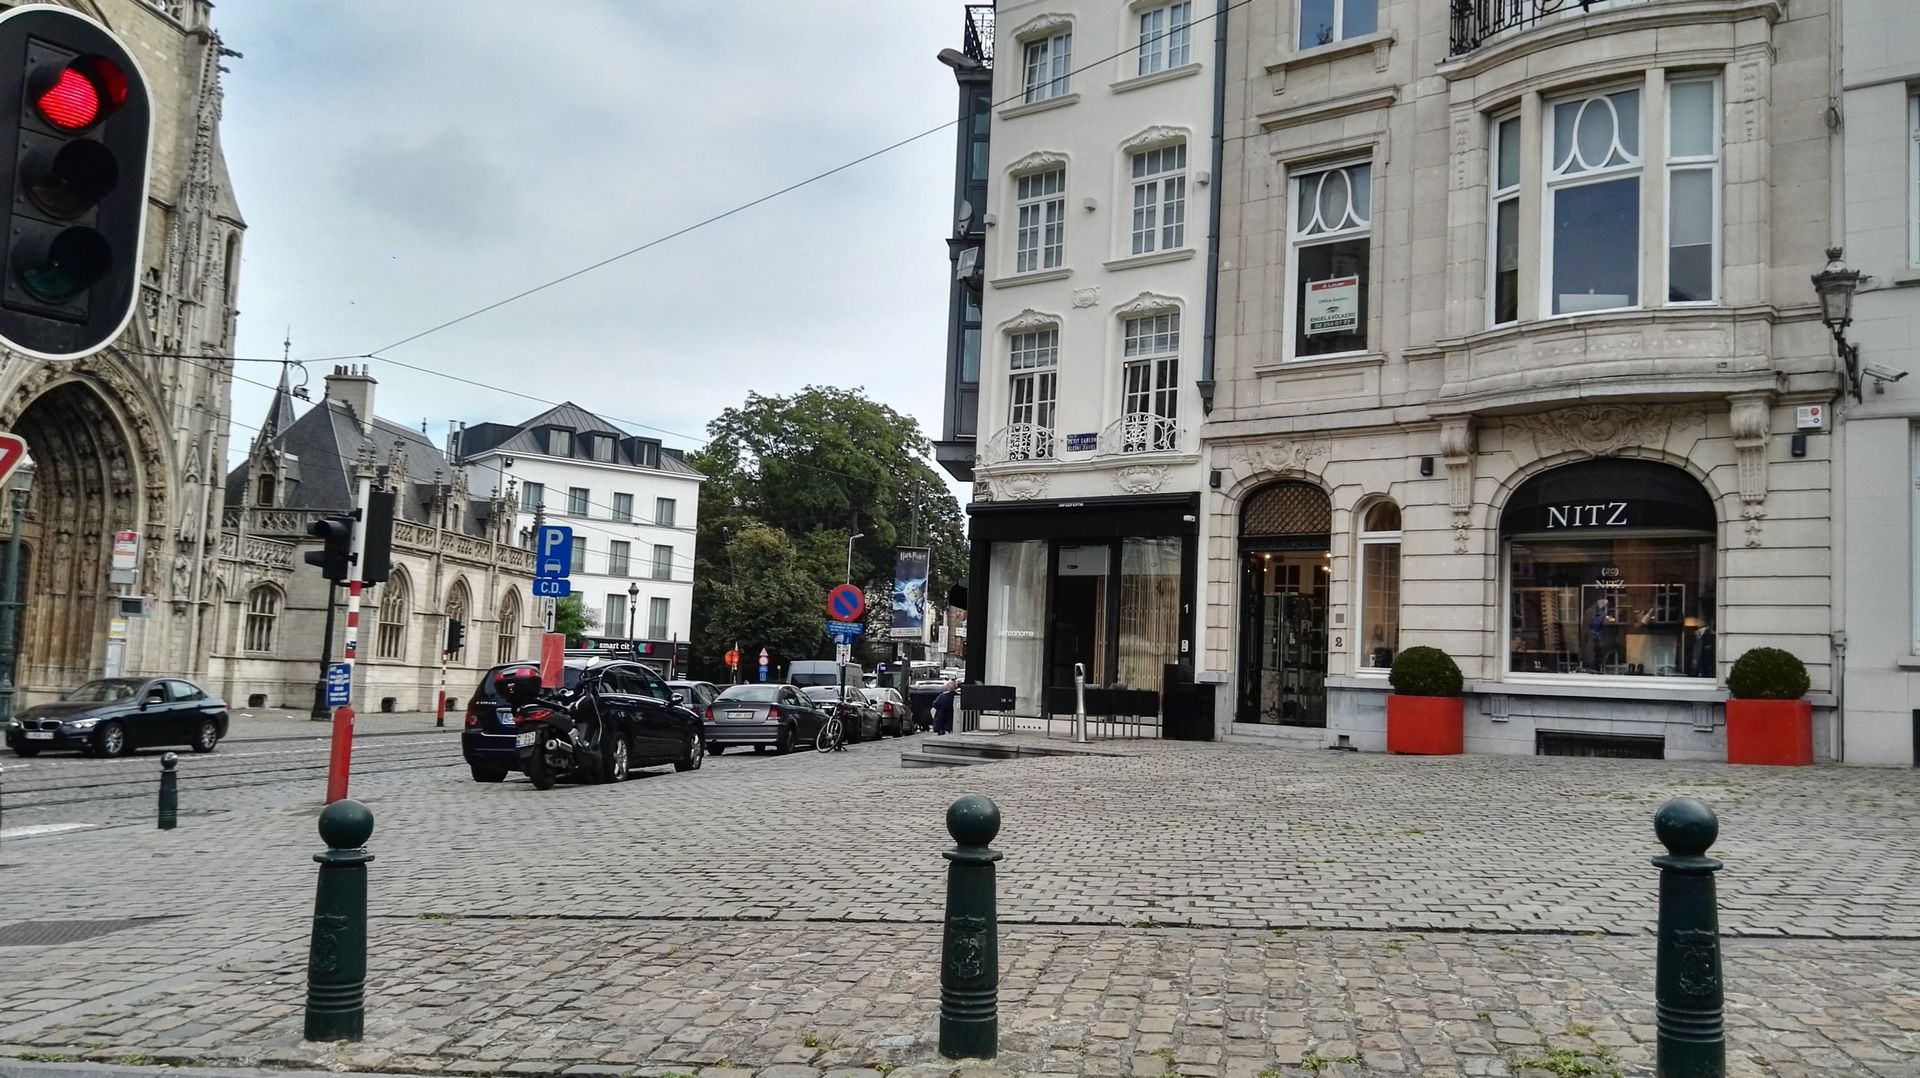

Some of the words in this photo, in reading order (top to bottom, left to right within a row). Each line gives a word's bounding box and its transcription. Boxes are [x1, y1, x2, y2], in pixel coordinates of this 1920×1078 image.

[1546, 502, 1628, 529] NITZ
[544, 528, 564, 557] P
[540, 582, 562, 594] C.D.
[598, 642, 620, 650] smart
[1335, 636, 1343, 648] 2
